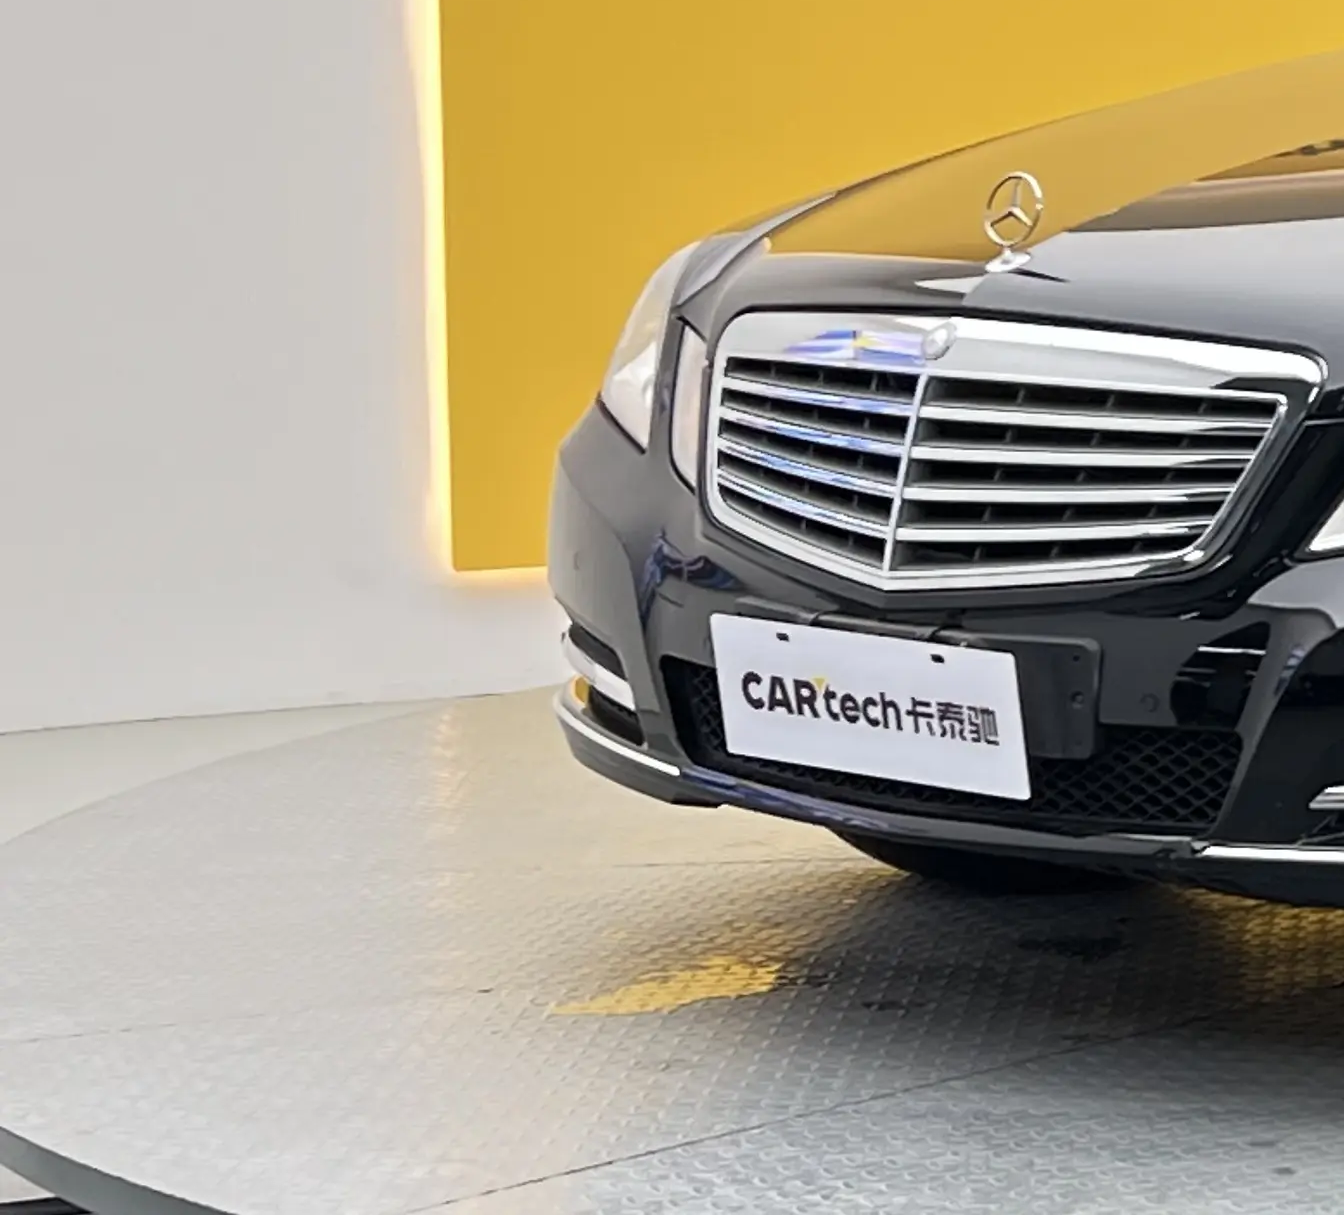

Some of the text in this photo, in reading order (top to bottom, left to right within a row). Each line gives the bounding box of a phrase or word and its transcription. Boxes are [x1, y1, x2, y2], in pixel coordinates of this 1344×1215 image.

[741, 671, 1000, 746] CARtech 卡泰驰
